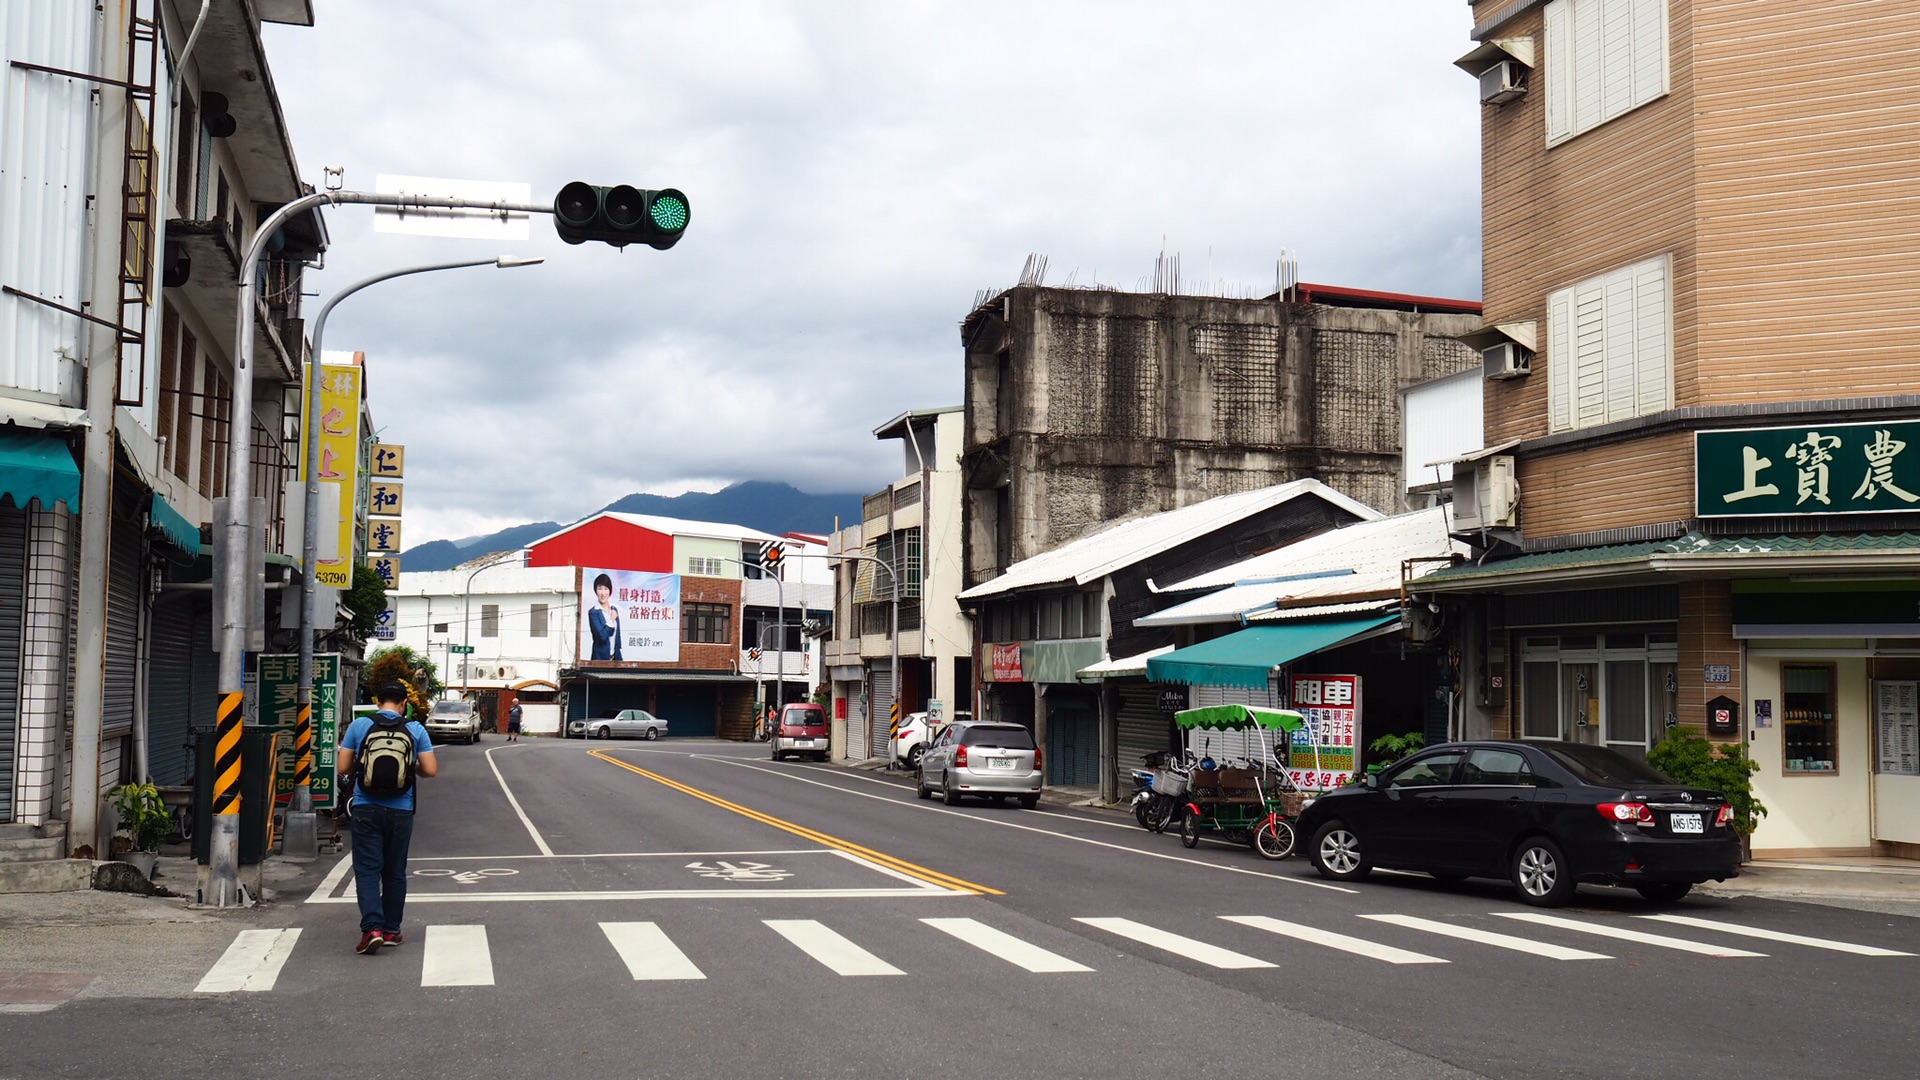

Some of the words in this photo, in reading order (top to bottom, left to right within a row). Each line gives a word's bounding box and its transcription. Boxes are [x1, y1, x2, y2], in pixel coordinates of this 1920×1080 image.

[1723, 429, 1920, 505] 上寶農
[629, 605, 675, 620] 富裕台東!
[1295, 679, 1352, 706] 租車
[322, 685, 336, 764] 火車站前
[1321, 709, 1331, 746] 協力車
[1333, 710, 1342, 746] 親子車
[1344, 710, 1353, 746] 淑女車
[277, 777, 330, 790] 8629
